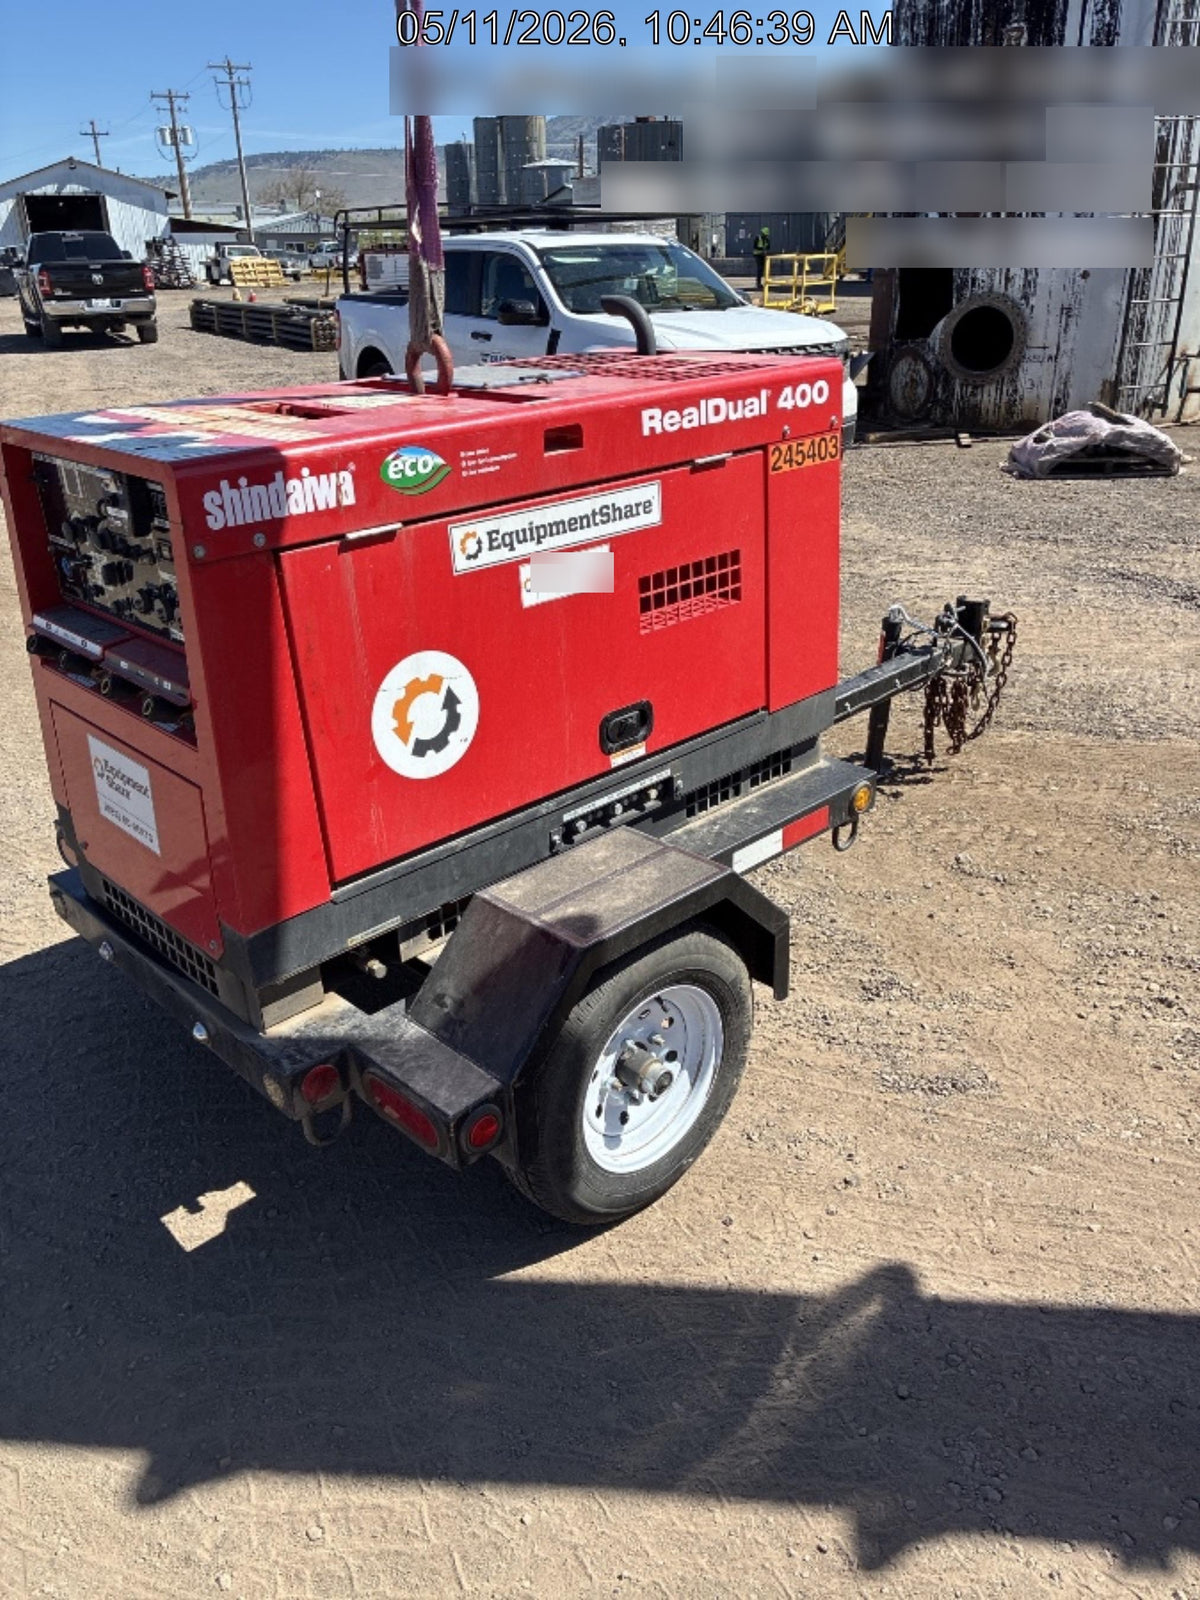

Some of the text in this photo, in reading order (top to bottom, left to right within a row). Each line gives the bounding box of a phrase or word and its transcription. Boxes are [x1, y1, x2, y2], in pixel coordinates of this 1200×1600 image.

[641, 380, 829, 436] RealDual 400
[387, 454, 435, 480] eco
[771, 435, 839, 472] 245403
[203, 467, 356, 530] shindaiwa
[486, 498, 653, 551] EquipmentShare
